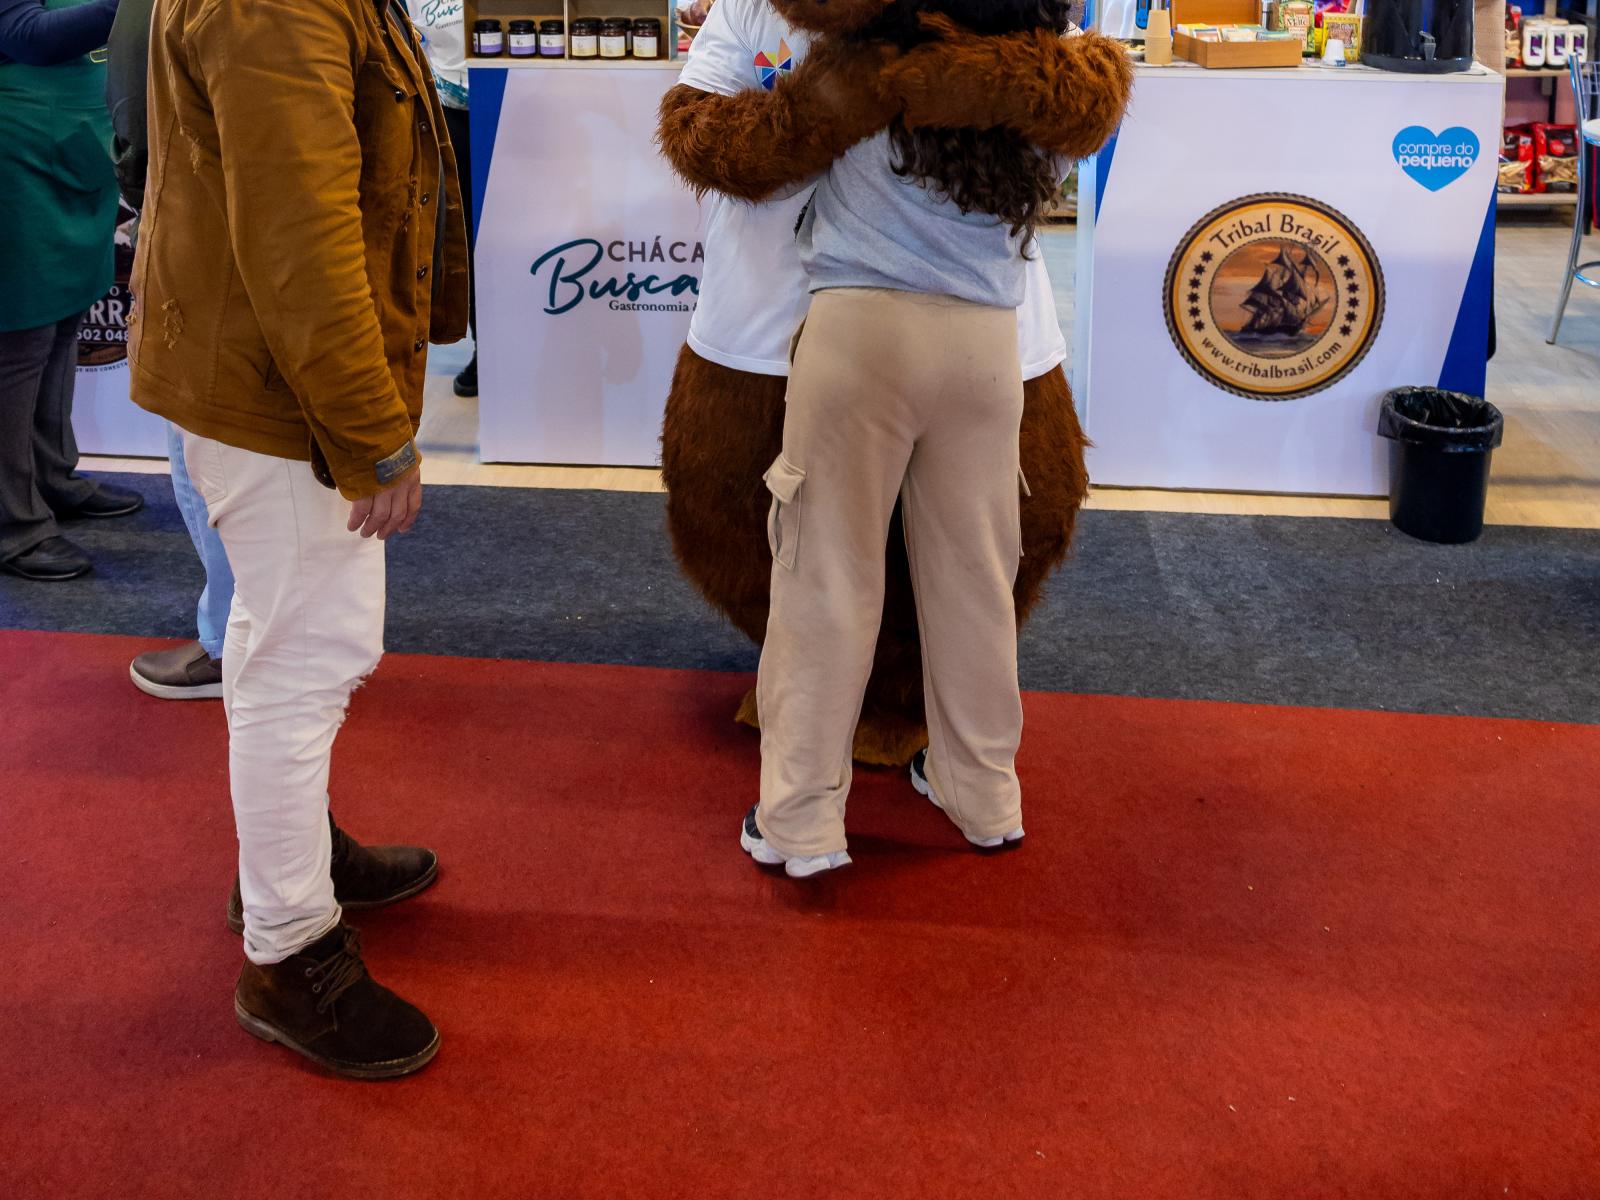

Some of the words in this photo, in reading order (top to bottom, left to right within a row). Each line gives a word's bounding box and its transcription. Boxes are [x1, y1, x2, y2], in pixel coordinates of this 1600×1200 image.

[1398, 143, 1452, 158] compre
[1455, 141, 1474, 155] do
[1398, 155, 1474, 170] pequeno
[1209, 213, 1271, 250] Tribal
[1279, 213, 1341, 255] Brasil
[607, 235, 705, 263] CHÁCA
[608, 300, 690, 313] Gastronomia
[1200, 337, 1343, 379] www.tribalbrasil.com
